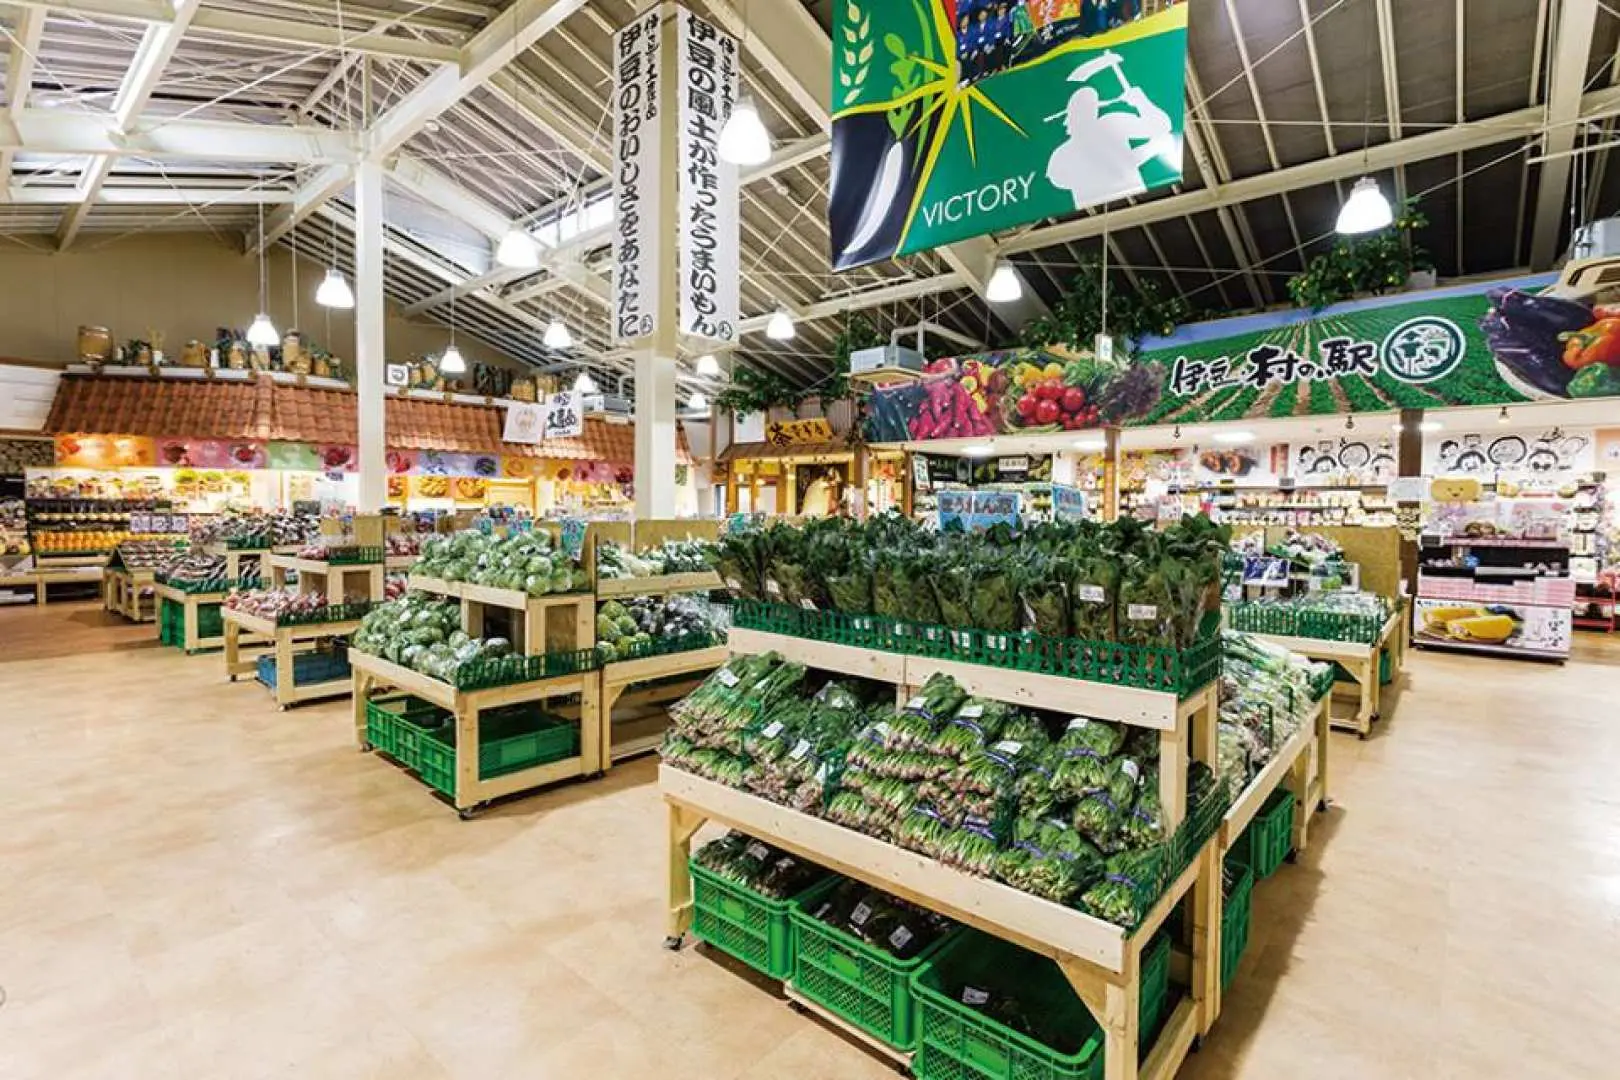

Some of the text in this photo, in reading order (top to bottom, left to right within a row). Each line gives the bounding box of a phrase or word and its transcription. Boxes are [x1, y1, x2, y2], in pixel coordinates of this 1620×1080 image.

[619, 24, 641, 337] 伊豆のおいしさをあなたに
[923, 171, 1036, 228] VICTORY
